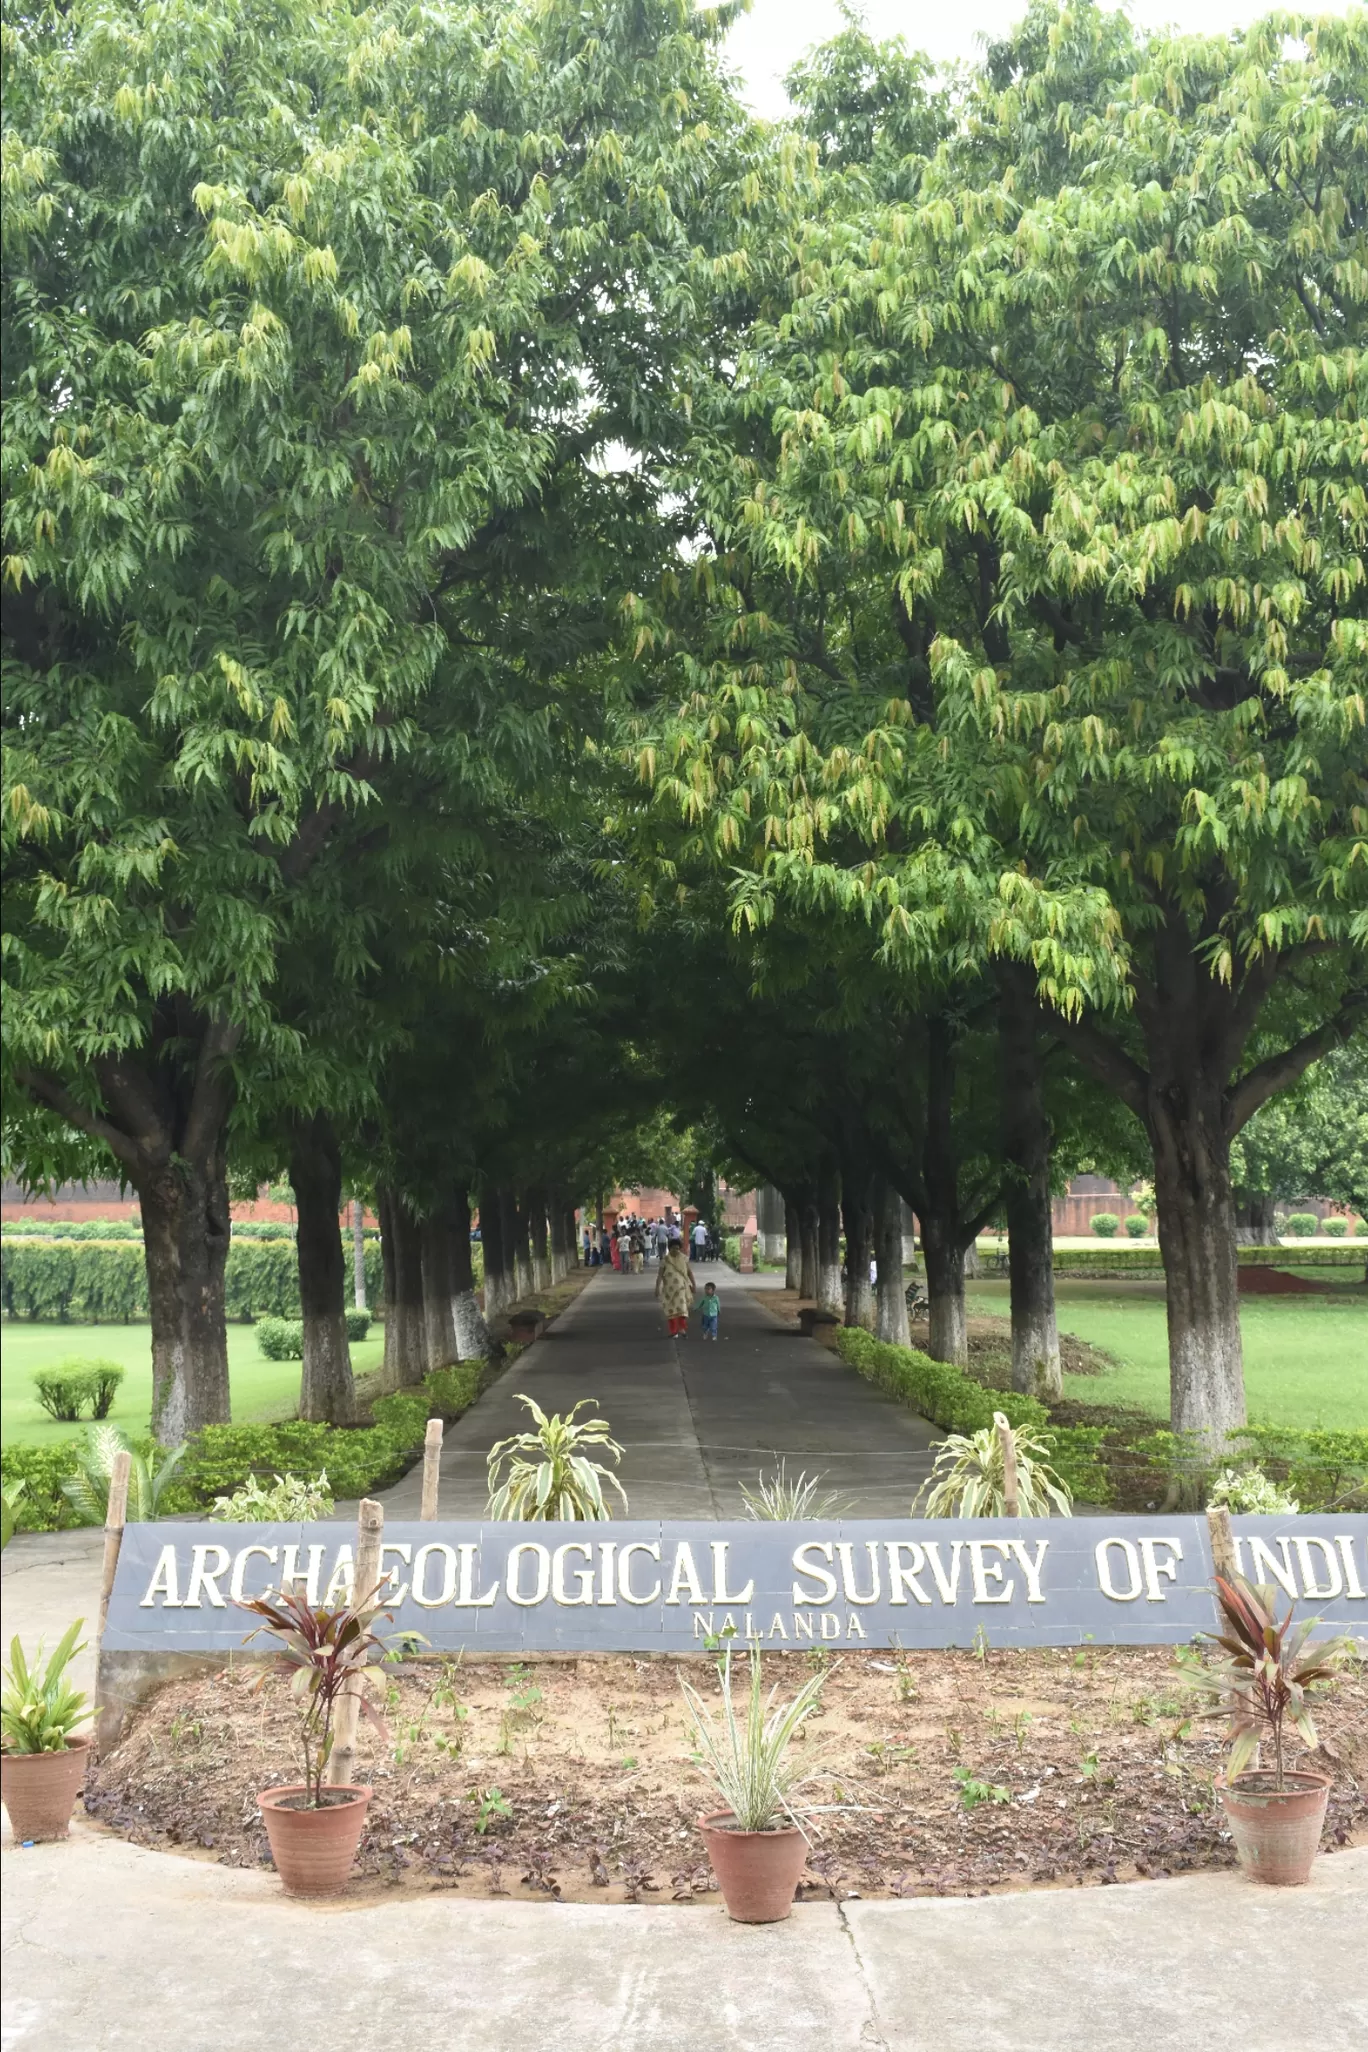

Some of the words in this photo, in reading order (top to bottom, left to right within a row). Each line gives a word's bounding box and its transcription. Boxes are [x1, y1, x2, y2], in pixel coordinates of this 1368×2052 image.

[139, 1541, 755, 1608] ARCHAEOLOGICAL
[793, 1540, 1049, 1606] SURVEY
[1096, 1537, 1183, 1603] OF
[1233, 1535, 1368, 1600] NDI
[692, 1611, 868, 1640] NALANDA
